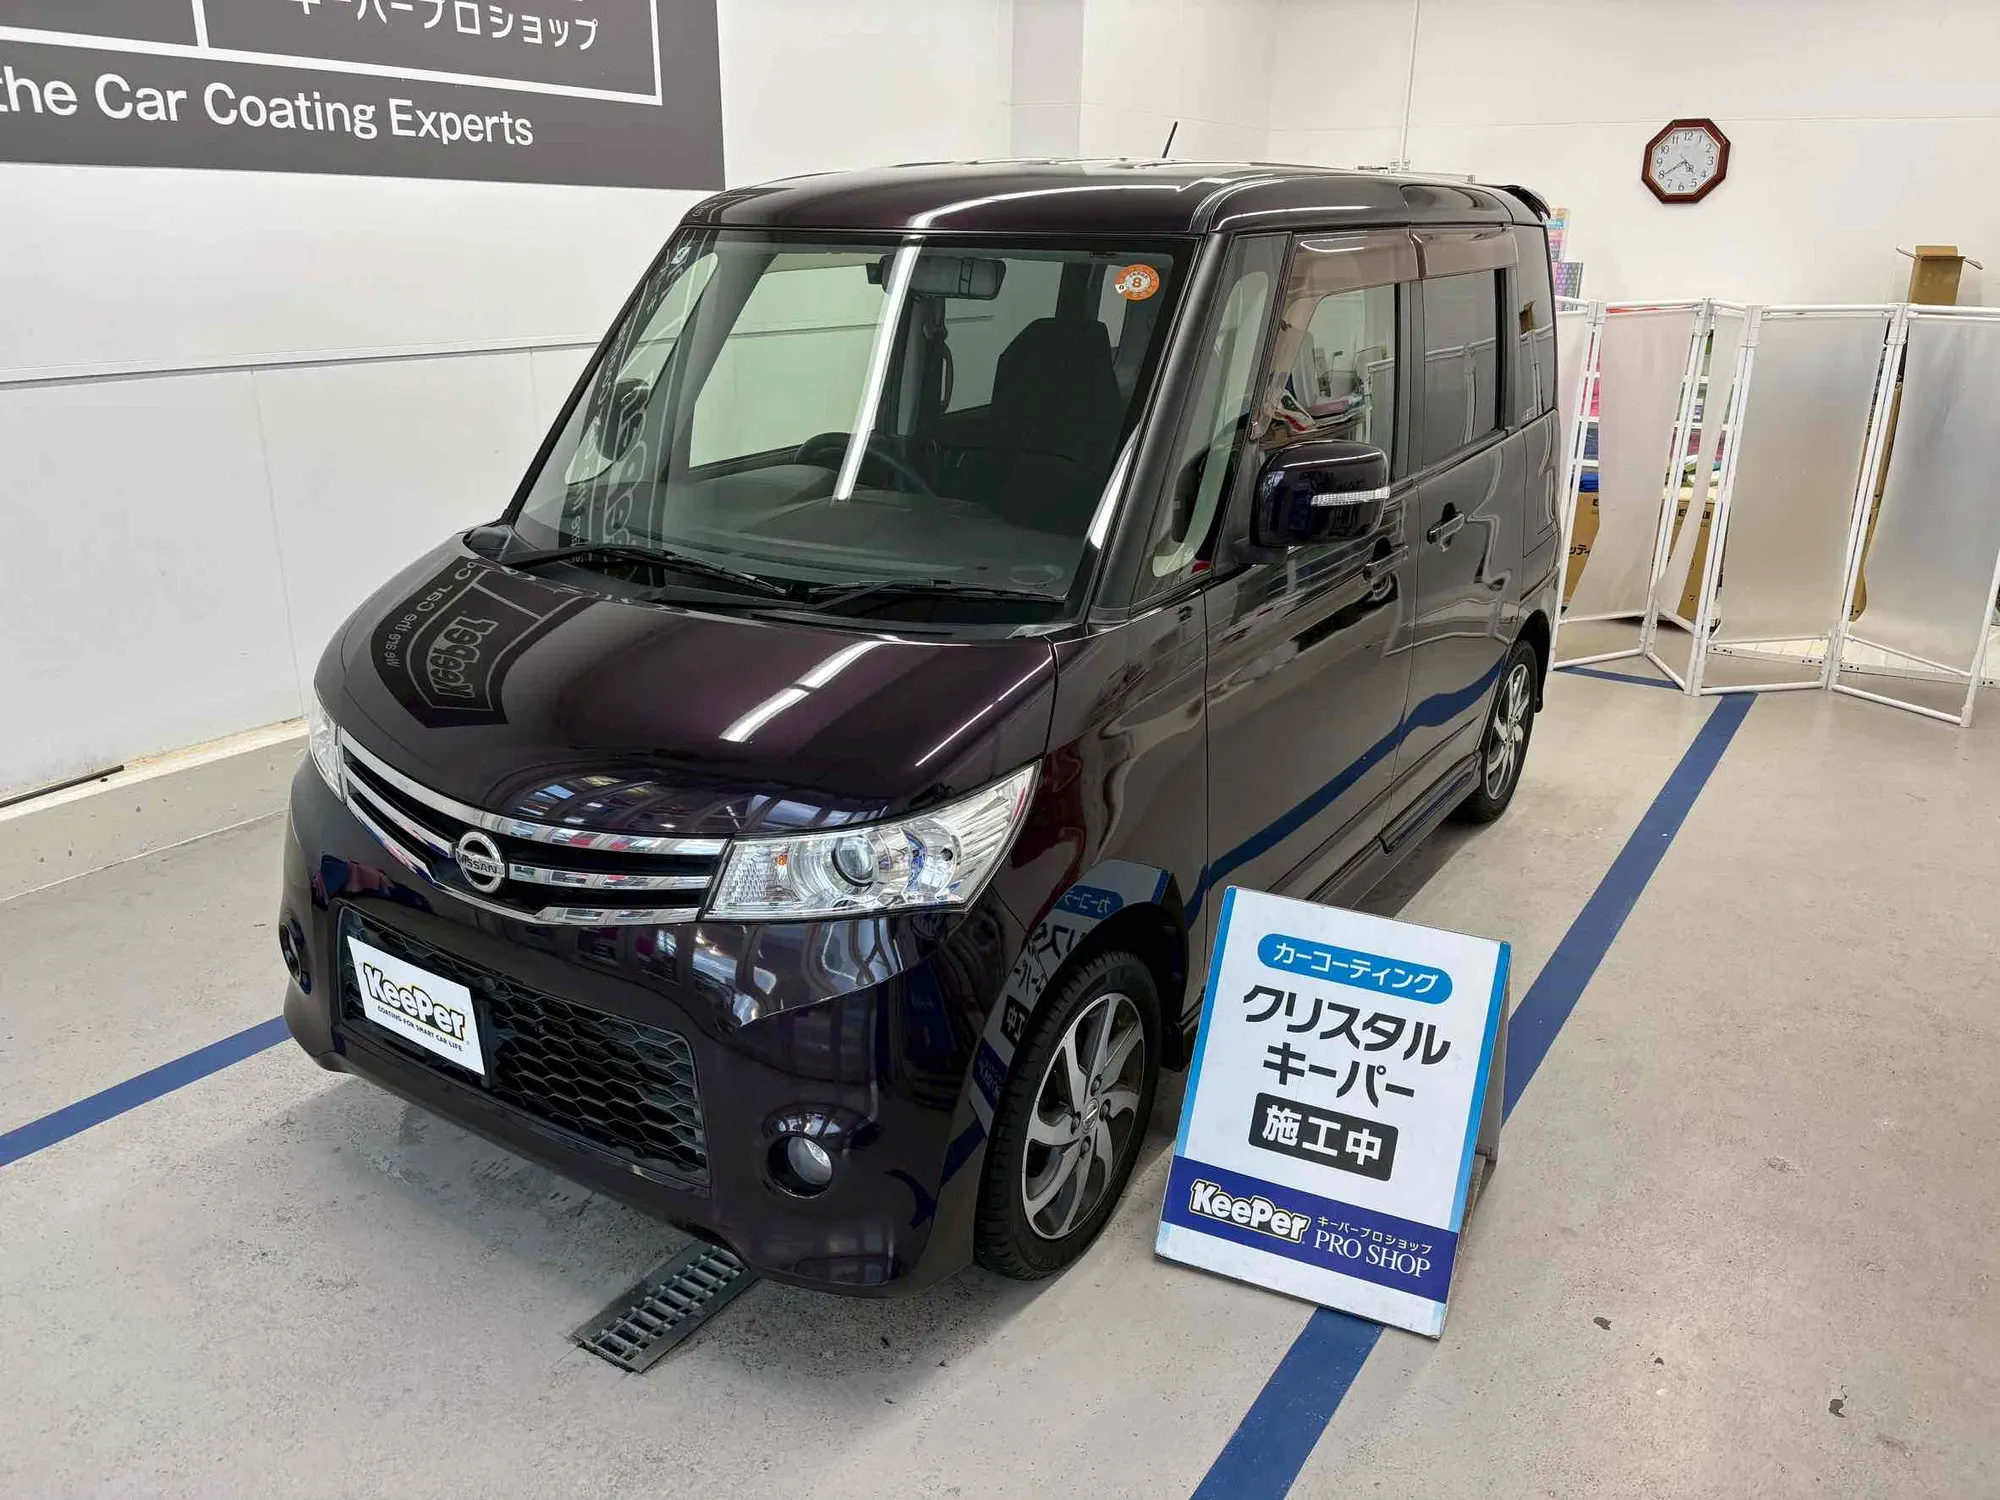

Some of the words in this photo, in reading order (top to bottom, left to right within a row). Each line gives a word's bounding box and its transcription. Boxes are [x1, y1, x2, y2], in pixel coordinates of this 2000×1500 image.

[290, 0, 599, 51] ープロショップ
[95, 73, 187, 122] Car
[203, 82, 376, 139] Coating
[390, 98, 534, 147] Experts
[1684, 131, 1693, 141] 12
[1705, 143, 1712, 153] 2
[1656, 157, 1663, 167] 9
[1658, 169, 1665, 179] 8
[1701, 169, 1707, 178] 4
[1707, 156, 1714, 166] 3
[1667, 179, 1673, 188] 7
[1678, 182, 1685, 191] 6
[1690, 178, 1698, 188] 5
[460, 853, 498, 874] NISSAN
[1273, 942, 1439, 994] カーコーティング
[363, 962, 466, 1042] KeePer
[377, 1005, 402, 1022] COATING
[403, 1017, 416, 1029] FOR
[416, 1024, 435, 1038] SMART
[435, 1034, 448, 1045] CAR
[448, 1040, 463, 1052] LIFE
[1242, 984, 1452, 1066] クリスタル
[1262, 1042, 1415, 1109] キーパー
[1262, 1104, 1383, 1167] 施工中
[1190, 1179, 1312, 1244] KeePer
[1313, 1229, 1362, 1259] PRO
[1365, 1244, 1431, 1278] SHOP
